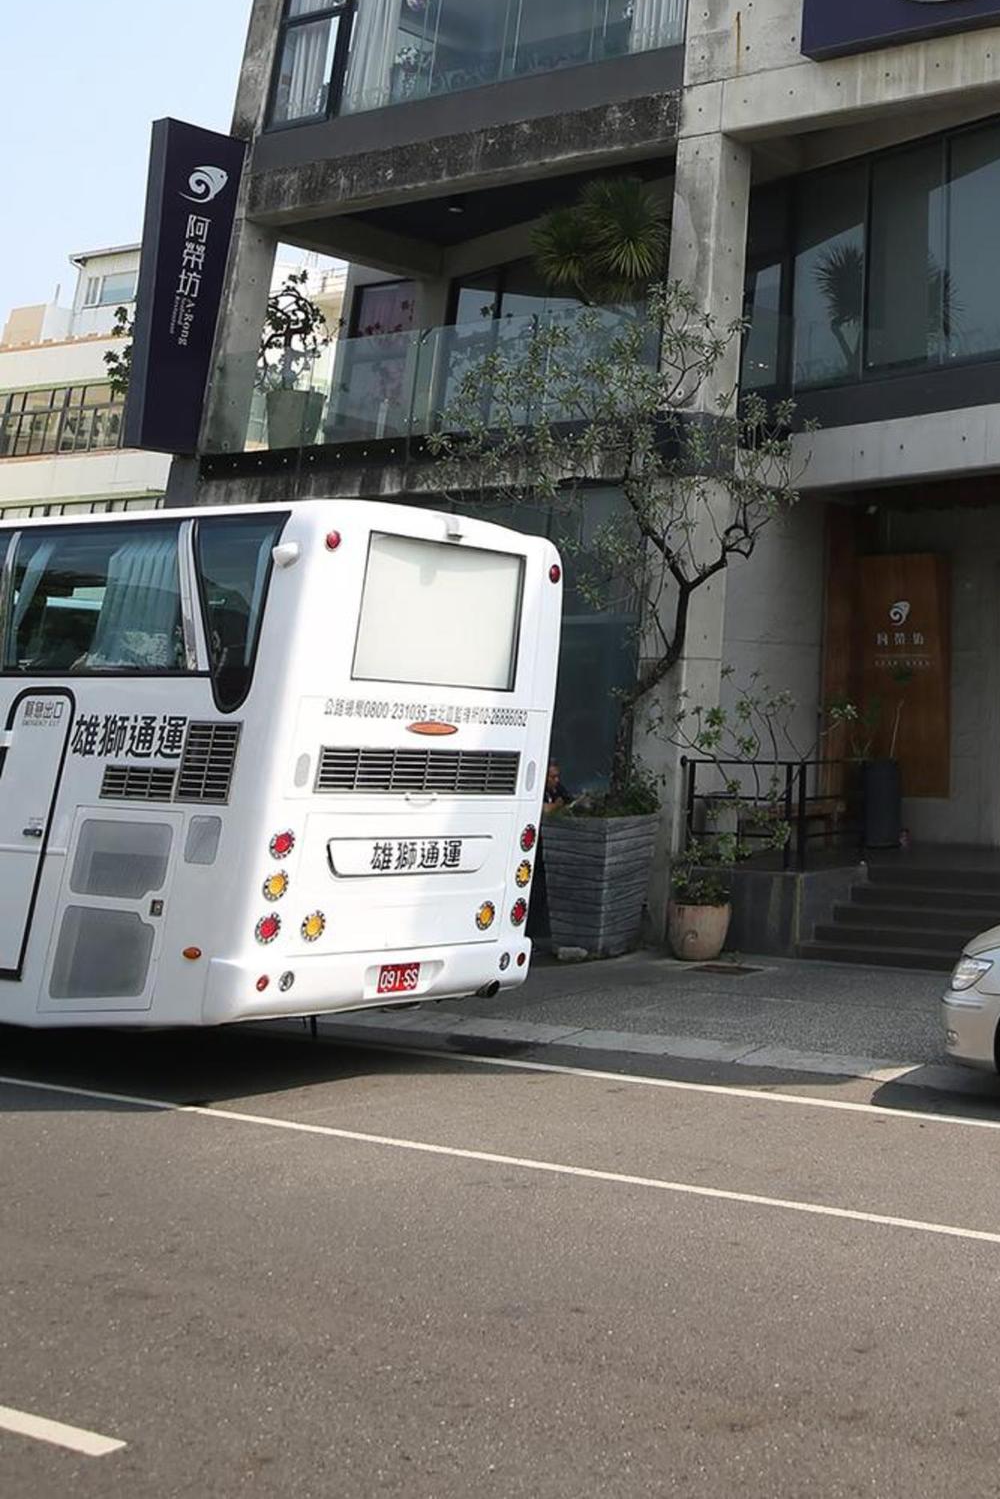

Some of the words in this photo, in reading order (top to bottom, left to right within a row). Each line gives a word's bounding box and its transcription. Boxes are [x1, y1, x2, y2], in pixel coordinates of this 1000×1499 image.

[176, 214, 211, 297] 阿榮坊
[71, 713, 188, 759] 雄獅通運
[370, 840, 462, 871] 雄獅通運
